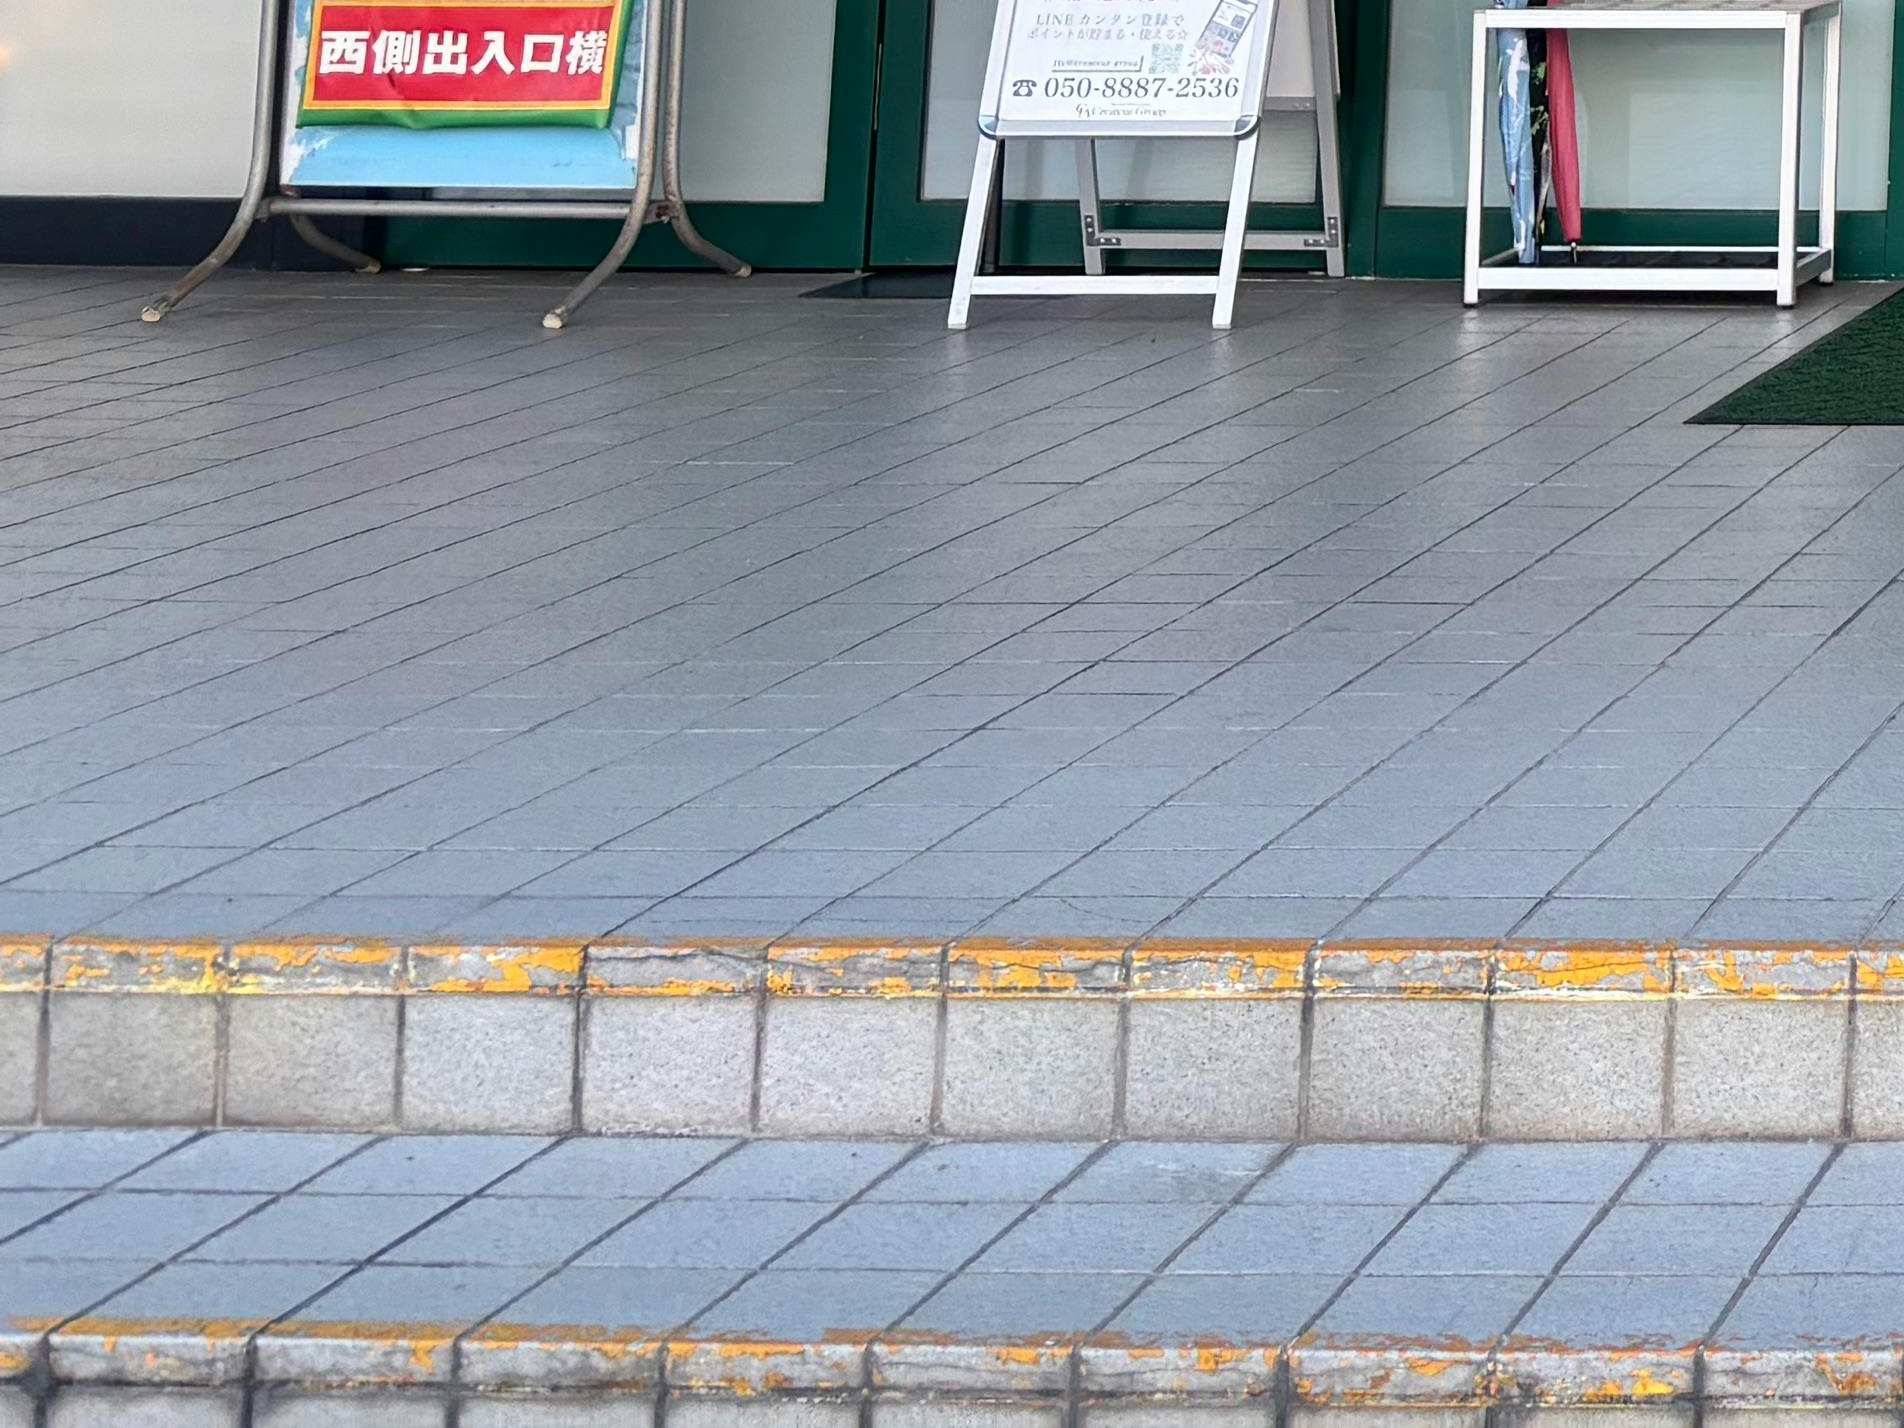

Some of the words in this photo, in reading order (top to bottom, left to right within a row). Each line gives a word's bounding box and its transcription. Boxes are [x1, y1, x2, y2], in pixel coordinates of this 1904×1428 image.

[1036, 13, 1074, 26] LINE
[318, 28, 608, 77] 西側出入口横
[1044, 76, 1239, 99] 050-8887-2536
